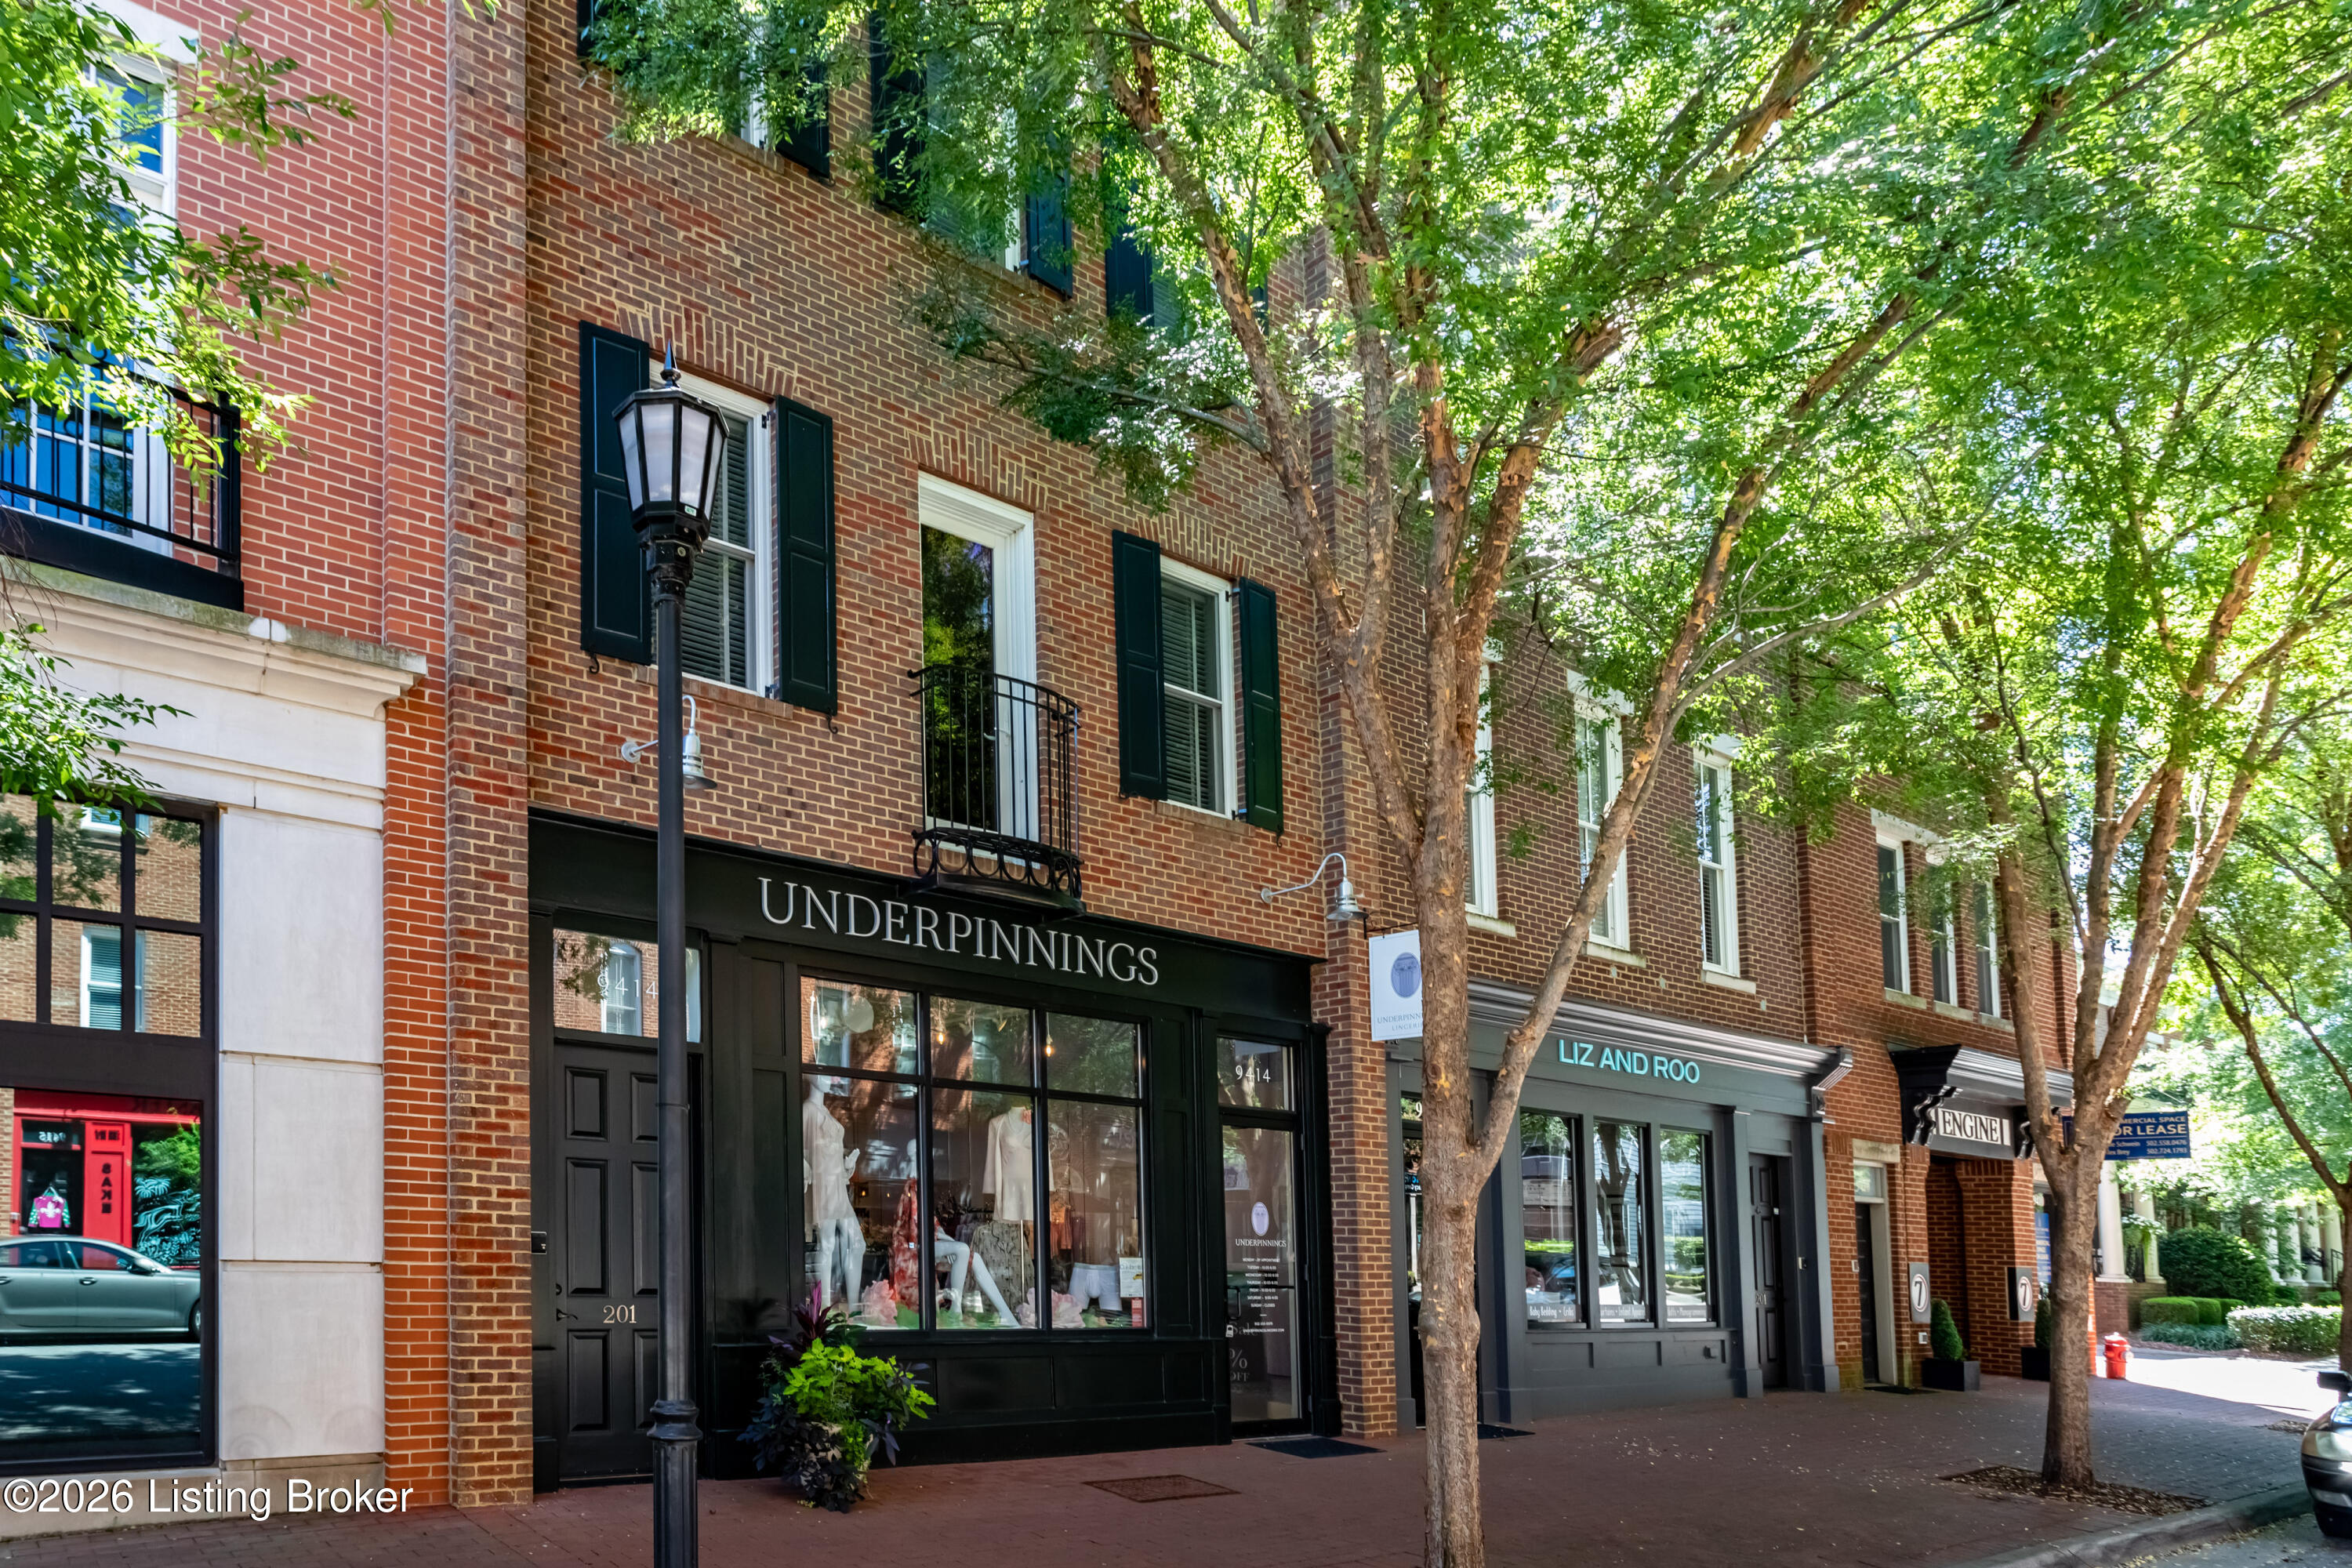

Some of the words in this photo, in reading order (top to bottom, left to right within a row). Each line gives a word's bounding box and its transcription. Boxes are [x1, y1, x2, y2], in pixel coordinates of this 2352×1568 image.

[758, 877, 1159, 985] UNDERPINNINGS
[597, 975, 659, 1000] 9414
[1377, 1012, 1421, 1024] UNDERPINN
[1559, 1039, 1595, 1067] LIZ
[1599, 1047, 1649, 1075] AND
[1653, 1055, 1700, 1083] ROO
[1236, 1065, 1271, 1083] 9414
[1941, 1109, 1998, 1142] ENGINE
[2114, 1125, 2133, 1136] OR
[2136, 1123, 2187, 1136] LEASE
[1235, 1238, 1287, 1247] UNDERPINNINGS
[1915, 1280, 1923, 1307] 7
[2020, 1283, 2027, 1307] 7
[603, 1305, 637, 1323] 201
